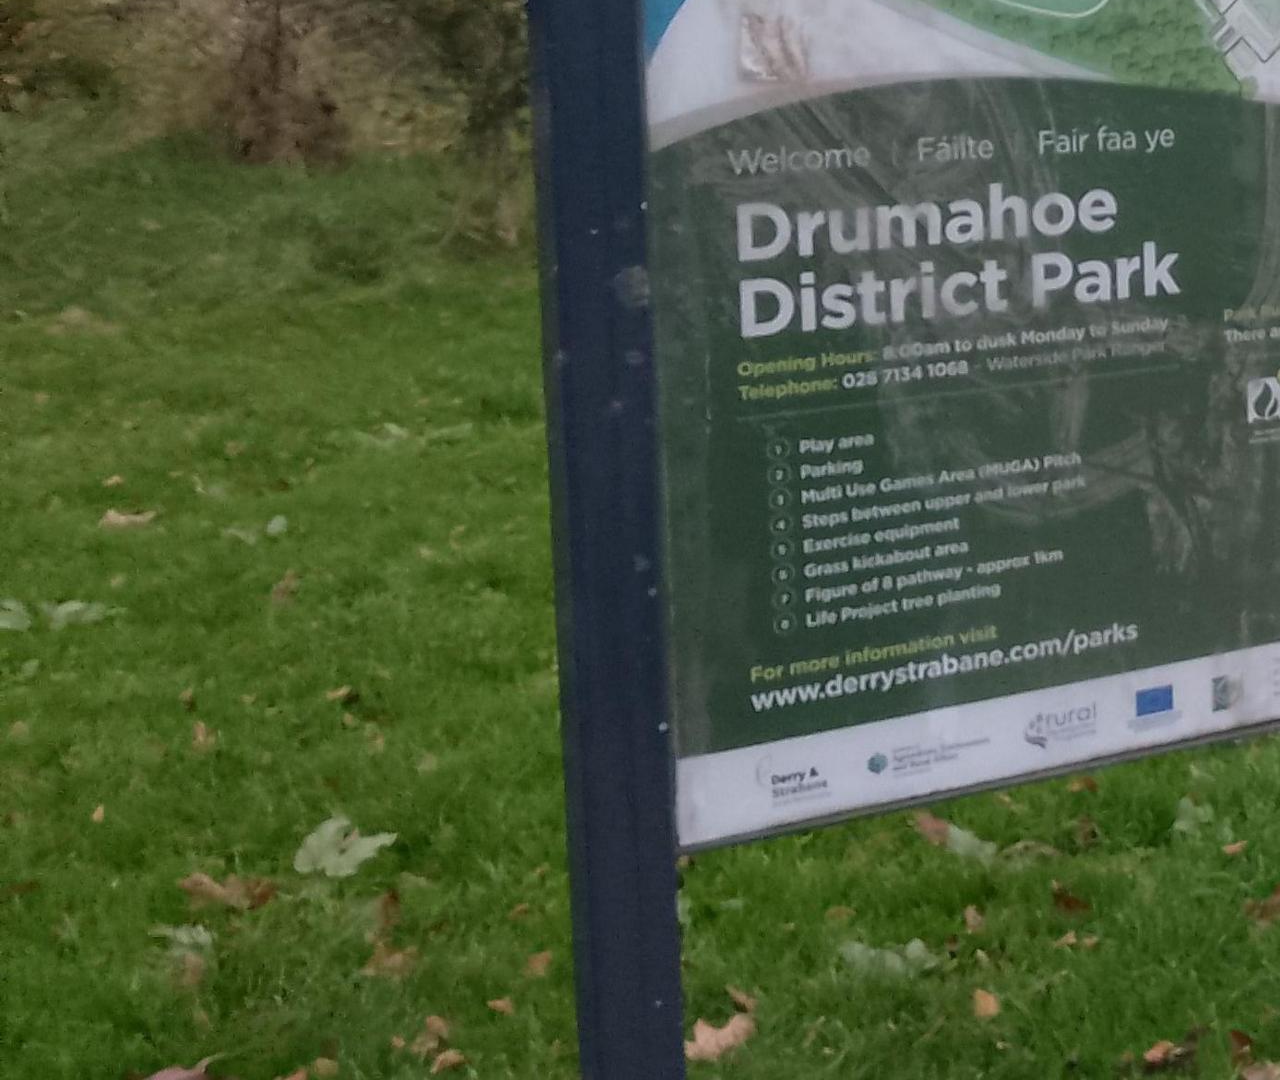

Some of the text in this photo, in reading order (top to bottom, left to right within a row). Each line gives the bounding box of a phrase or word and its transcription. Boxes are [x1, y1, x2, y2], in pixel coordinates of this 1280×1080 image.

[727, 125, 1177, 176] Welcome Fáilte Fair faa ye
[736, 182, 1119, 262] Drumahoe
[739, 240, 1182, 338] District Park
[737, 357, 816, 378] Opening
[955, 337, 972, 353] to
[976, 332, 1016, 350] dusk
[1021, 326, 1086, 345] Monday
[1090, 323, 1106, 337] to
[1111, 316, 1168, 336] Sunday
[1223, 327, 1266, 343] There
[738, 377, 838, 401] Telephone:
[842, 371, 879, 389] 028
[882, 365, 923, 384] 7134
[927, 360, 969, 379] 1068
[799, 438, 834, 454] Play
[838, 434, 874, 449] area
[800, 460, 864, 480] Parking
[801, 484, 843, 504] Multi
[845, 482, 877, 497] Use
[880, 474, 935, 492] Games
[939, 468, 975, 483] Area
[977, 457, 1040, 478] (MUGA)
[1043, 451, 1082, 469] Pitch
[802, 511, 849, 529] Steps
[851, 500, 922, 522] between
[924, 493, 971, 511] upper
[974, 487, 1004, 503] and
[1007, 482, 1049, 498] lower
[1052, 475, 1087, 496] park
[803, 532, 872, 554] Exercise
[874, 517, 960, 542] equipment
[804, 561, 849, 578] Grass
[852, 546, 931, 570] kickabout
[934, 542, 969, 557] area
[805, 583, 859, 602] Figure
[861, 576, 880, 593] of
[882, 575, 893, 591] 8
[896, 566, 964, 591] pathway
[977, 556, 1031, 575] approx
[1034, 550, 1064, 564] 1km
[806, 610, 838, 628] Life
[841, 599, 899, 621] Project
[901, 594, 934, 611] tree
[936, 583, 1002, 607] planting
[750, 623, 998, 684] For more information visit
[751, 620, 1139, 712] www.derrystrabane.com/parks
[1045, 701, 1097, 727] rural
[771, 771, 806, 785] Derry
